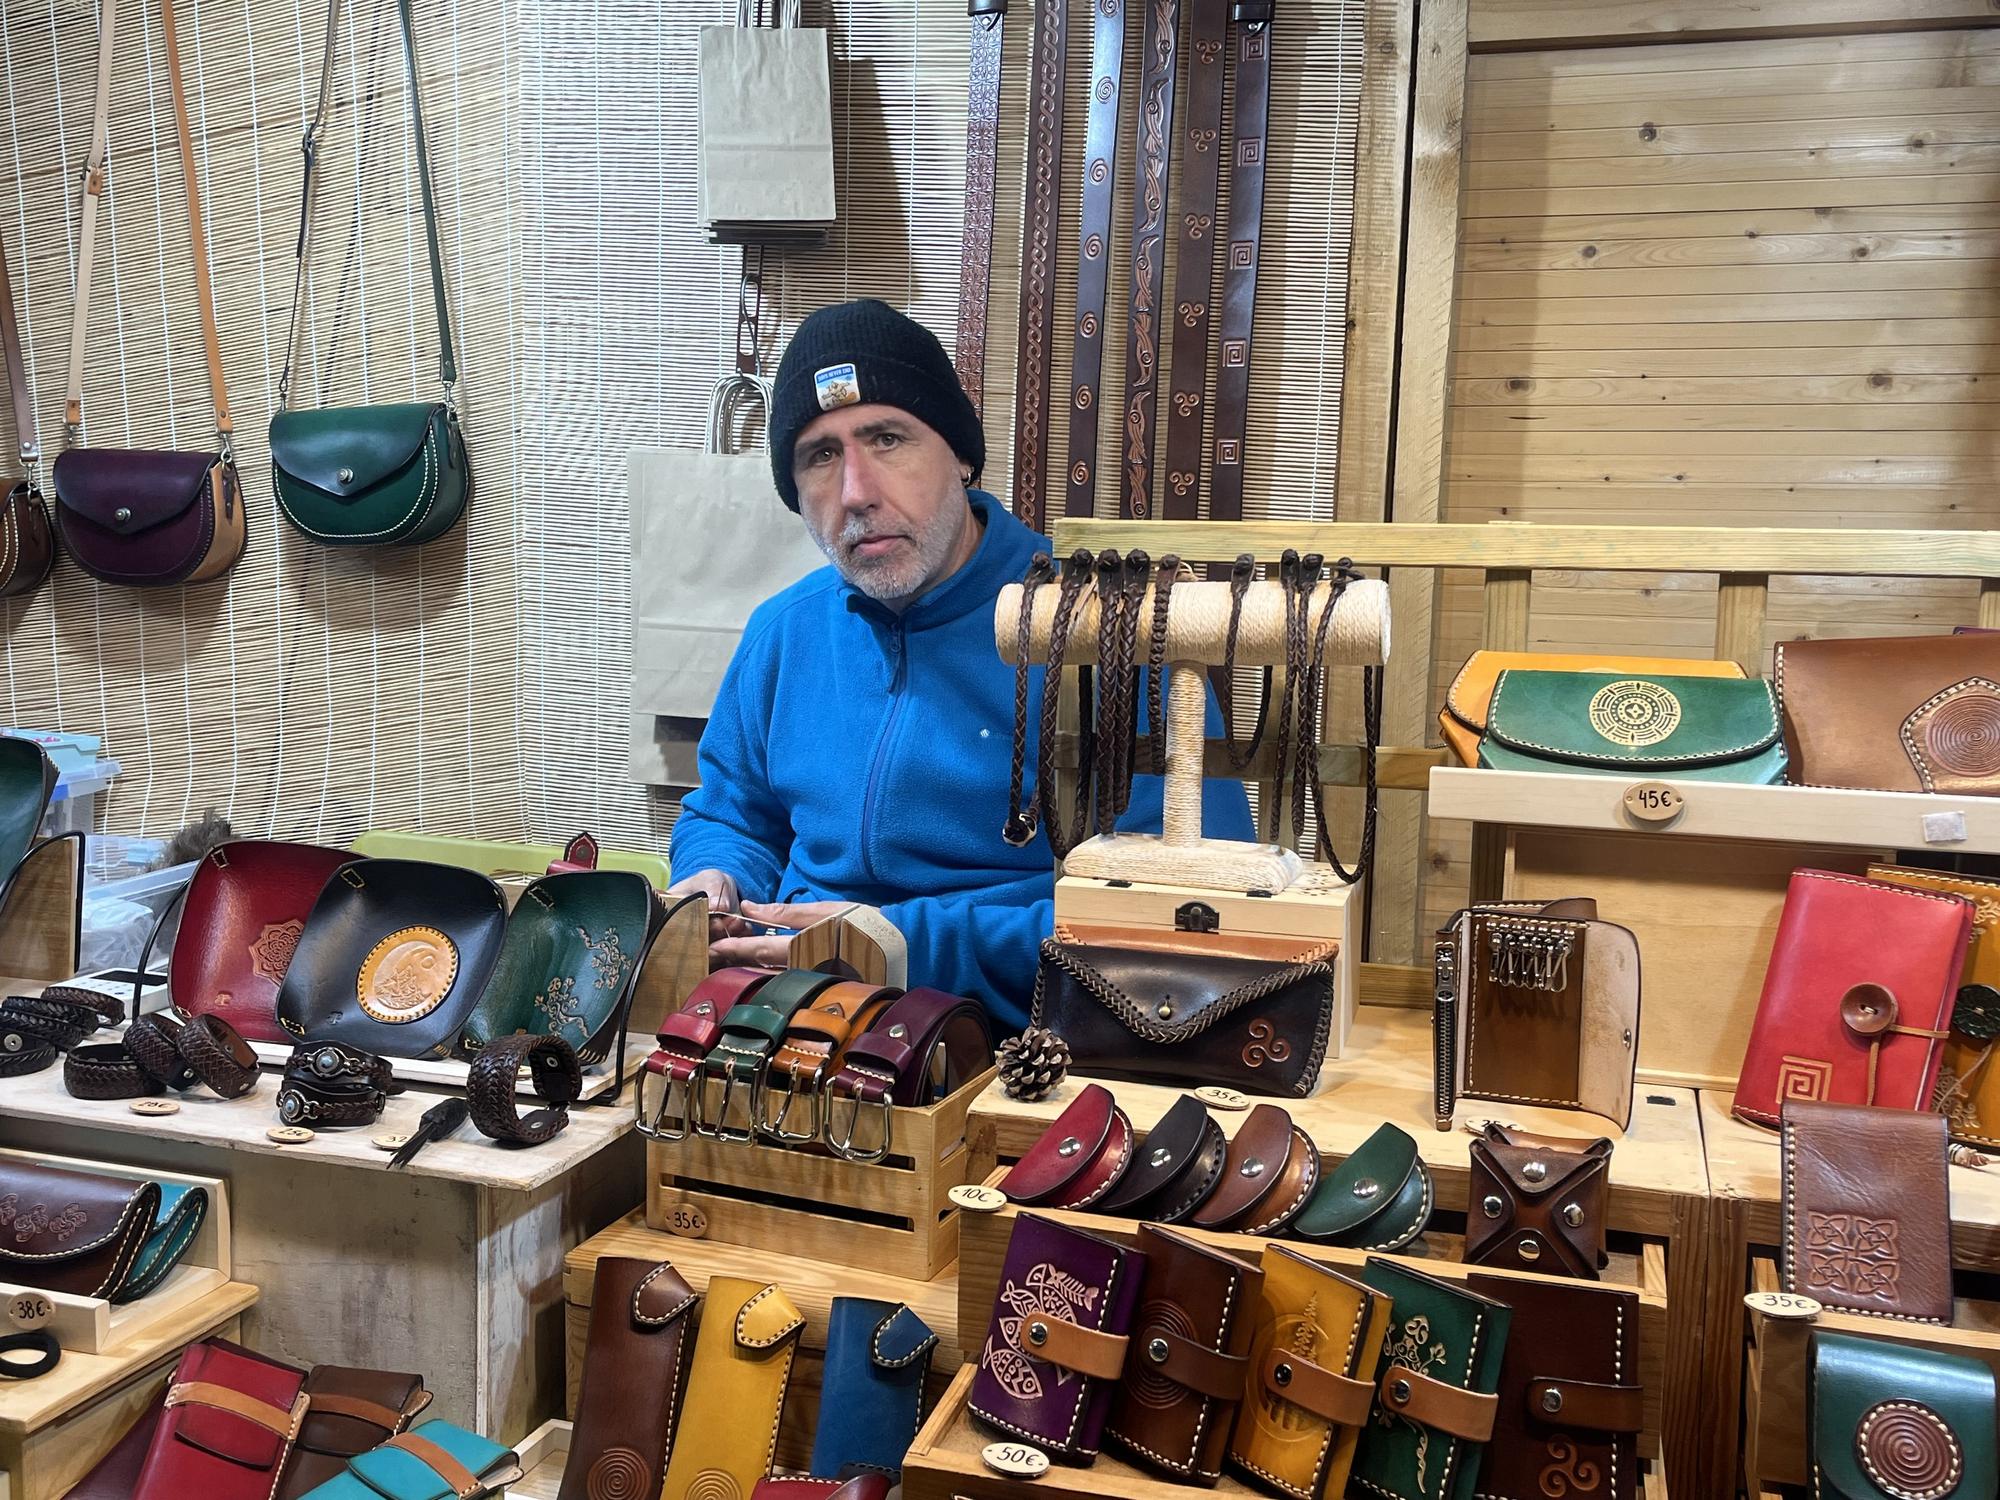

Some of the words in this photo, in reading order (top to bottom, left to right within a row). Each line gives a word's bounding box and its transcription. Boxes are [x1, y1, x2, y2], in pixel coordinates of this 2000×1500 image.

[1638, 789, 1671, 808] 45€
[1206, 1089, 1242, 1103] 35€
[674, 1211, 701, 1229] 35€
[17, 1300, 46, 1319] 38€
[1763, 1294, 1808, 1309] 35€
[996, 1446, 1040, 1466] 50€
